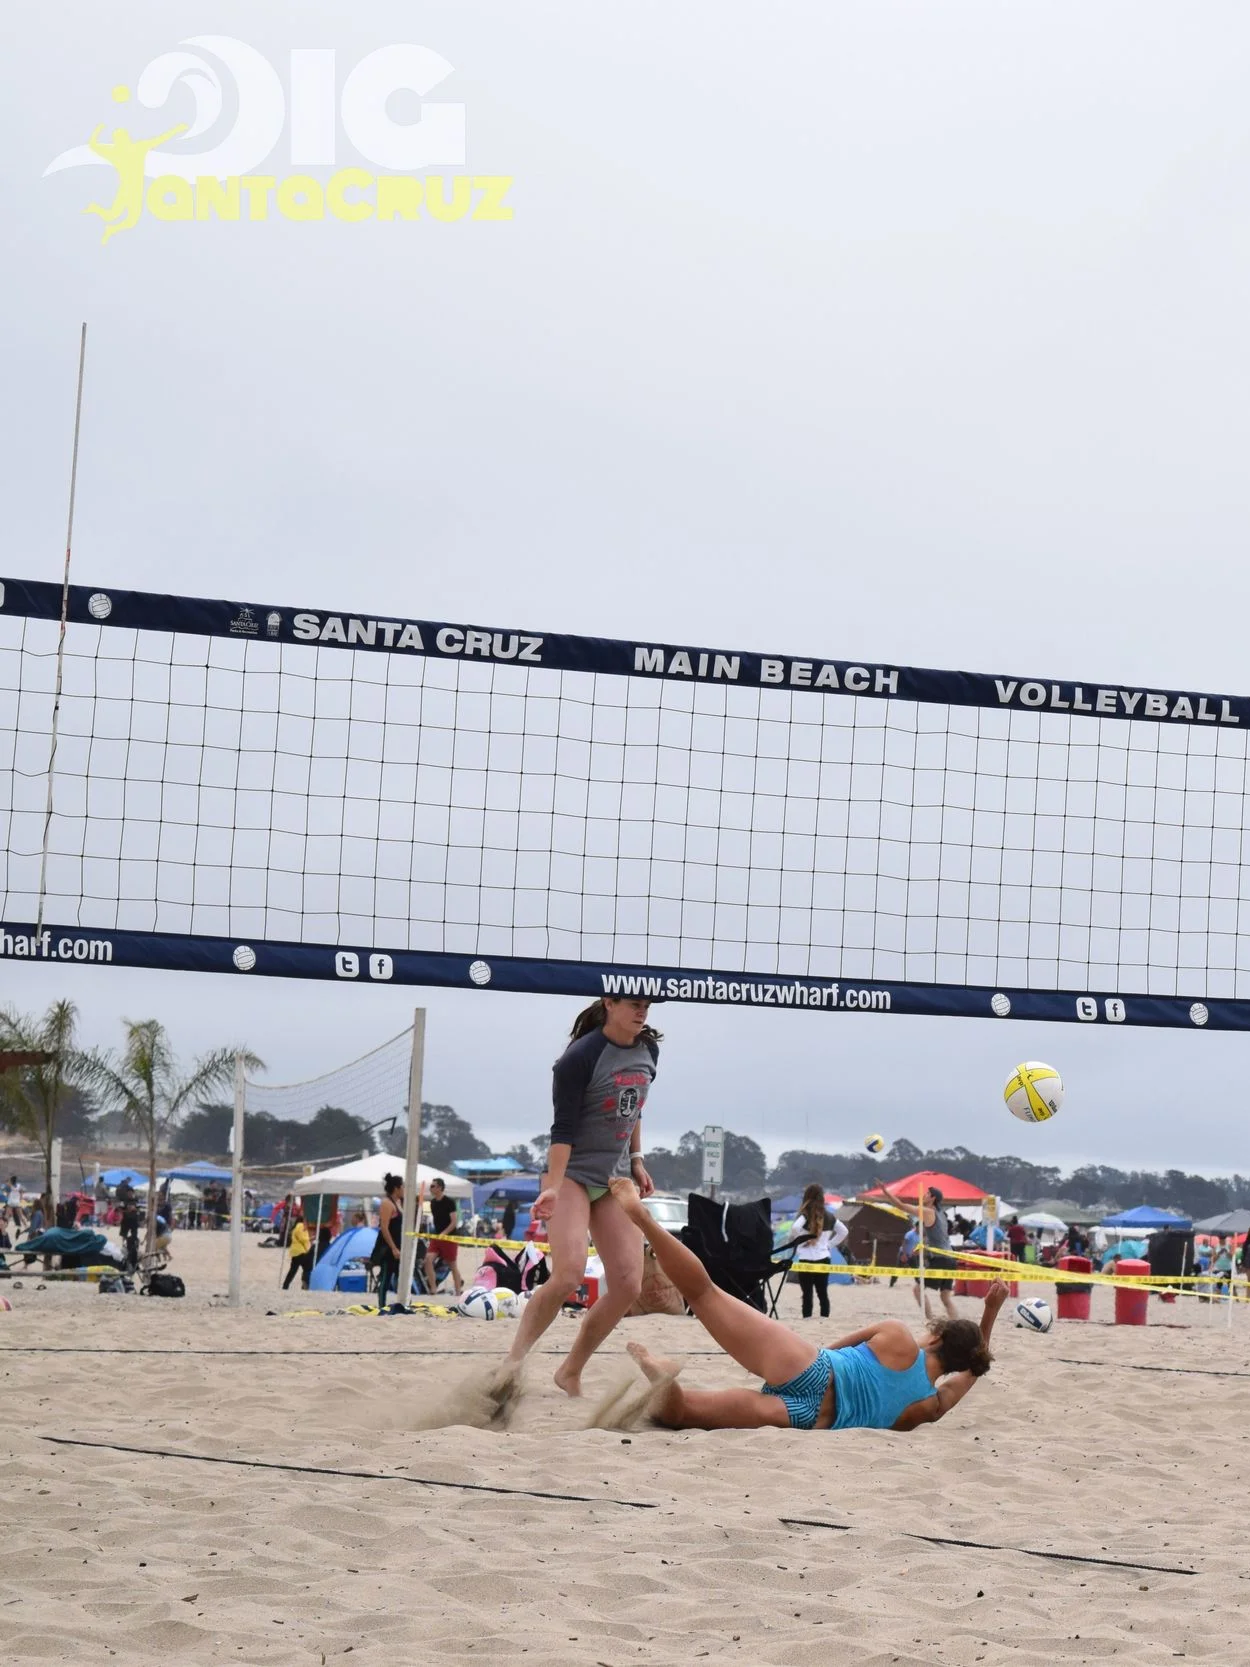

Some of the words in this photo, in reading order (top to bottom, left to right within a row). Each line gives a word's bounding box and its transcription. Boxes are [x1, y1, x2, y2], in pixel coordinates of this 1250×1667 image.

[292, 613, 425, 650] SANTA
[435, 627, 544, 662] CRUZ
[633, 646, 741, 681] MAIN
[759, 659, 900, 695] BEACH
[994, 680, 1241, 724] VOLLEYBALL
[601, 973, 892, 1010] www.santacruzwharf.com
